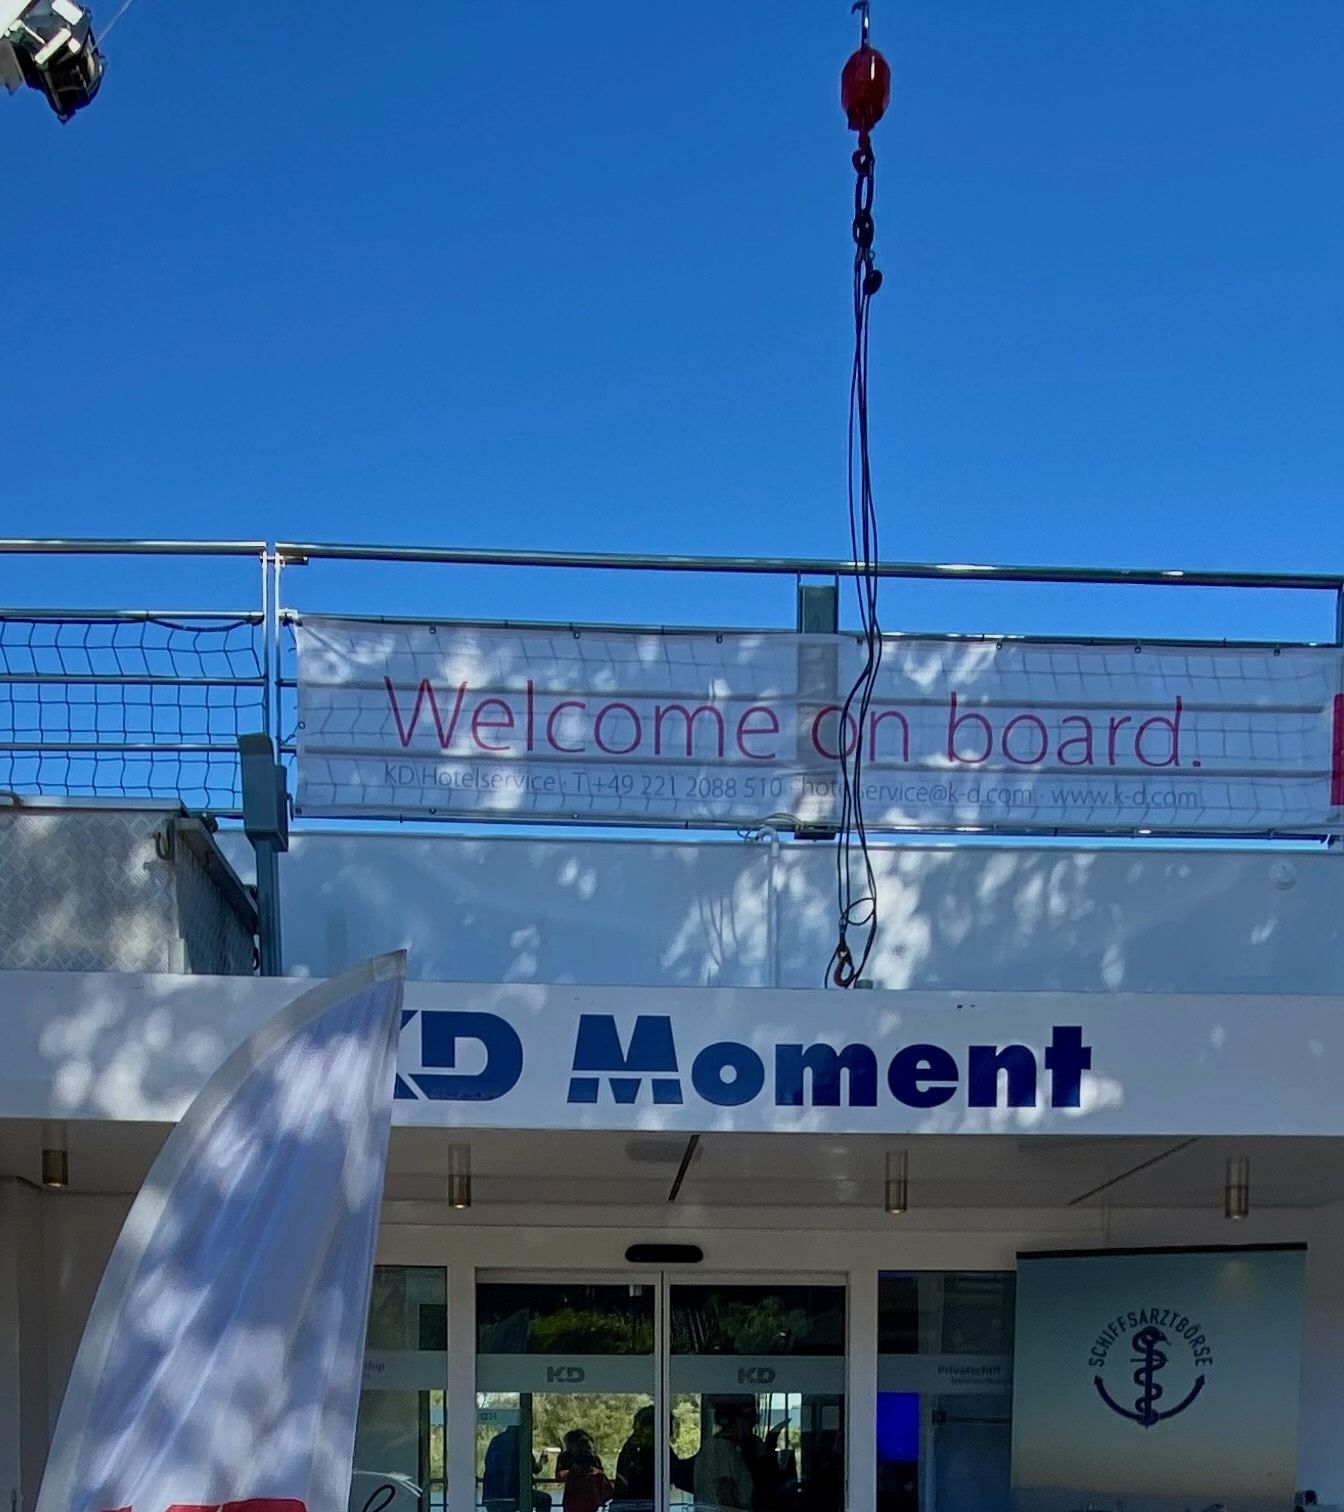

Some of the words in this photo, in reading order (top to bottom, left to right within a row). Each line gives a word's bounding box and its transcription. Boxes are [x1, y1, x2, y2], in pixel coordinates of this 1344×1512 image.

[383, 675, 780, 759] Welcome
[811, 704, 910, 763] on
[947, 691, 1201, 768] board.
[384, 764, 414, 785] KD
[422, 766, 556, 792] Hotelservice
[592, 774, 634, 795] +49
[641, 775, 676, 798] 221
[686, 776, 737, 799] 2088
[743, 777, 783, 798] 510
[1051, 785, 1199, 808] www.k-d.com
[566, 1014, 1092, 1108] Moment
[1088, 1307, 1214, 1368] SCHIFFSARZTBÖRSE
[547, 1366, 585, 1383] KD
